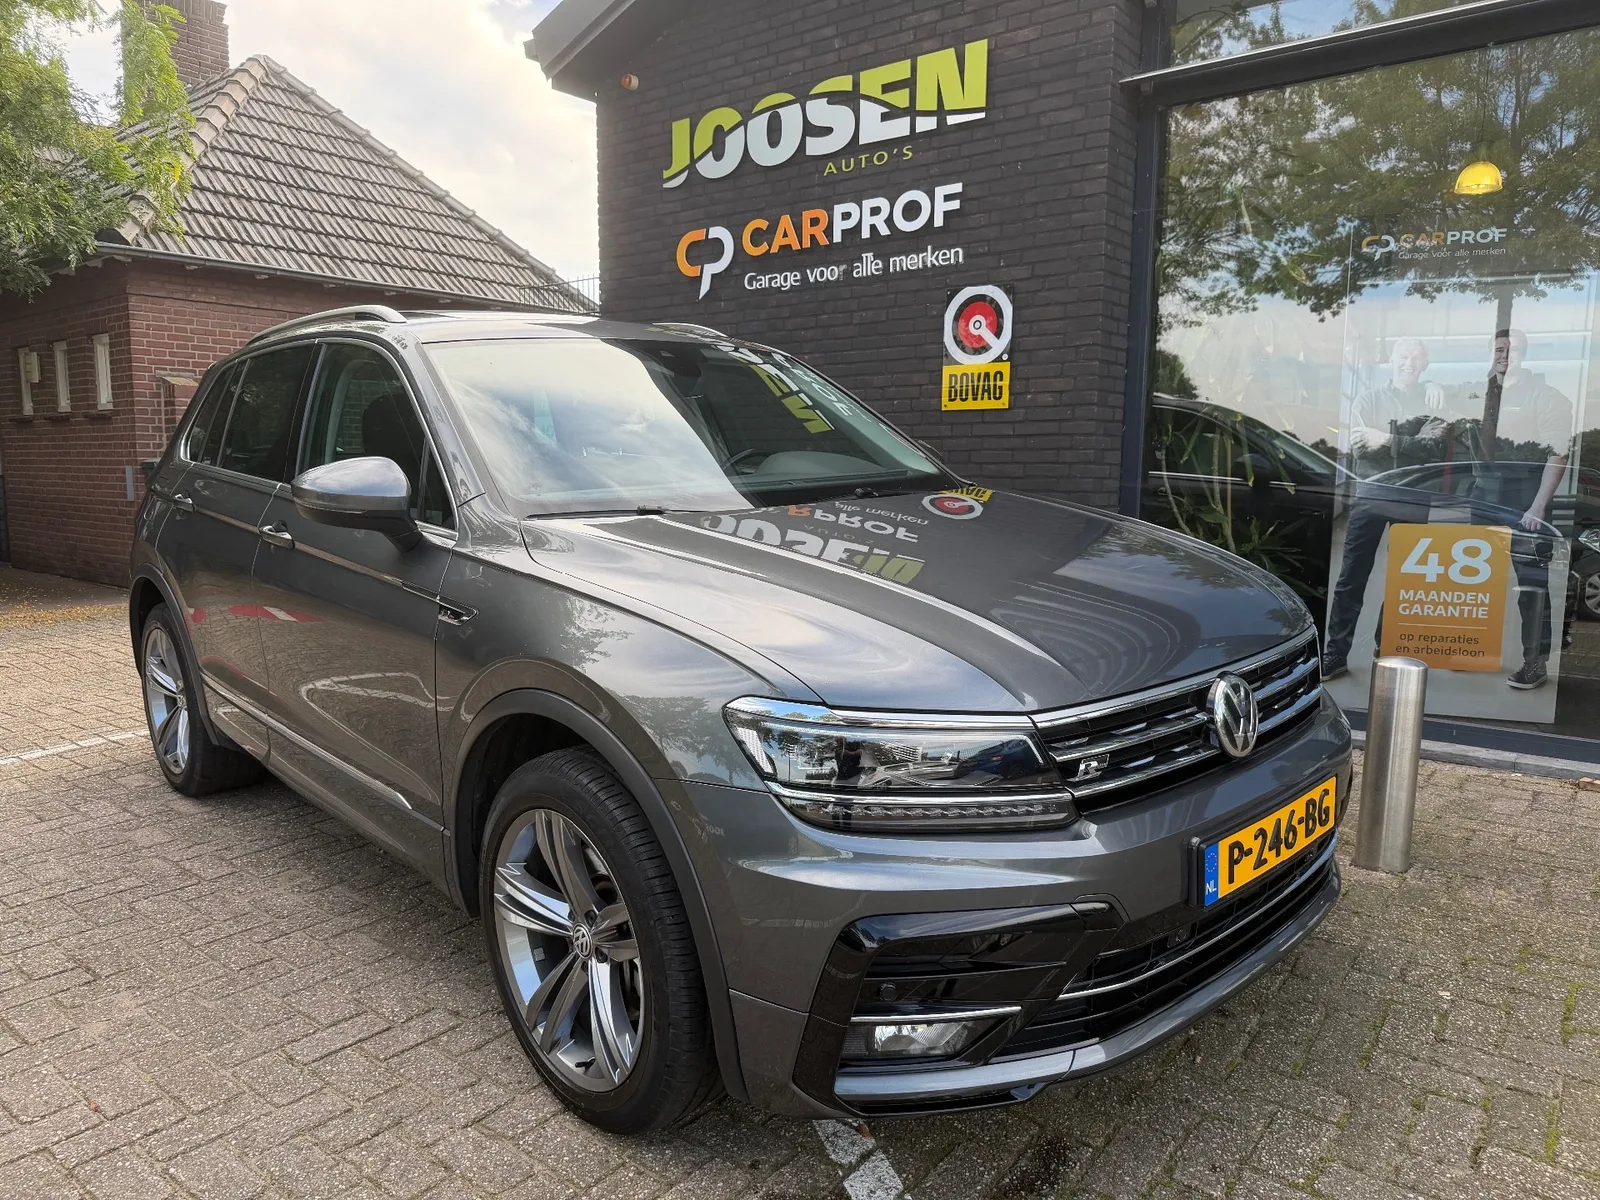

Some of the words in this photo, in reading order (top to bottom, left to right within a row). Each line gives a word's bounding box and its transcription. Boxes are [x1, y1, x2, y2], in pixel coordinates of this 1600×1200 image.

[663, 39, 988, 188] JOOSEN
[823, 145, 913, 176] AUTO'S
[742, 182, 963, 256] CARPROF
[1400, 228, 1507, 248] CARPROF
[1398, 250, 1428, 260] Garage
[1431, 250, 1451, 258] voor
[1455, 249, 1469, 257] alle
[1472, 247, 1506, 256] merken
[744, 271, 800, 291] Garage
[807, 263, 847, 282] voor
[853, 252, 883, 278] alle
[890, 245, 963, 274] merken
[947, 370, 1004, 402] BOVAG
[1400, 537, 1492, 584] 48
[1399, 589, 1490, 604] MAANDEN
[1398, 603, 1488, 619] GARANTIE
[1395, 645, 1410, 653] en
[1413, 645, 1485, 658] arbeidsloon
[1399, 633, 1414, 643] op
[1418, 634, 1479, 645] reparaties
[1228, 789, 1330, 885] P-246-BG
[1205, 880, 1217, 895] NL
